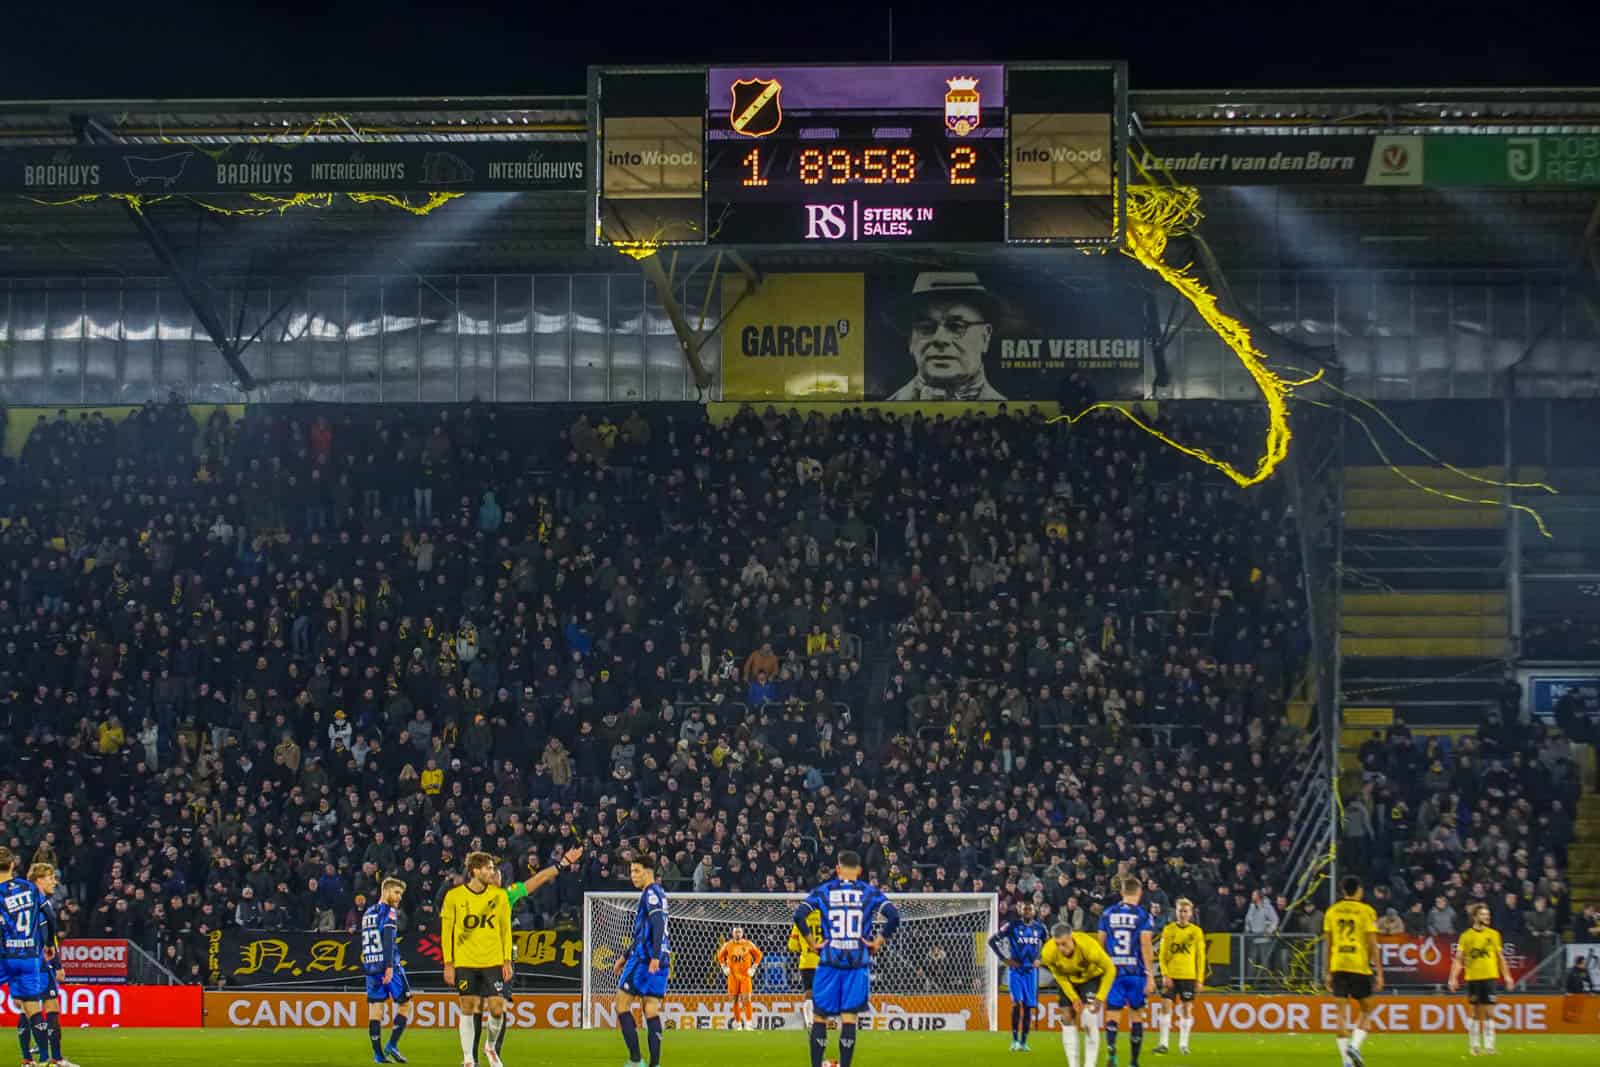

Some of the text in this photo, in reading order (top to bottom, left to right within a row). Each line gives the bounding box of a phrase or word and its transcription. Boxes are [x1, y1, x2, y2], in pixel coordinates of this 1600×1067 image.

[25, 165, 99, 185] BADHUYS
[217, 163, 293, 184] BADHUYS
[311, 163, 405, 180] INTERIEURHUYS
[488, 162, 583, 179] INTERIEURHUYS
[743, 146, 976, 186] 1 89:58 2
[804, 204, 846, 239] RS
[863, 208, 933, 221] STERK IN
[863, 222, 912, 235] SALES.
[742, 325, 839, 357] GARCIA
[1001, 339, 1139, 358] RAT VERLEGH
[16, 911, 32, 937] 4
[463, 914, 496, 929] OK
[828, 909, 864, 938] 30
[362, 929, 383, 954] 23
[1113, 930, 1131, 955] 3
[61, 946, 126, 960] NOORT
[228, 1000, 357, 1027] CANON
[857, 1016, 947, 1031] EEQUIP
[1203, 1002, 1310, 1029] VOOR
[1420, 1003, 1548, 1031] DIVSIE
